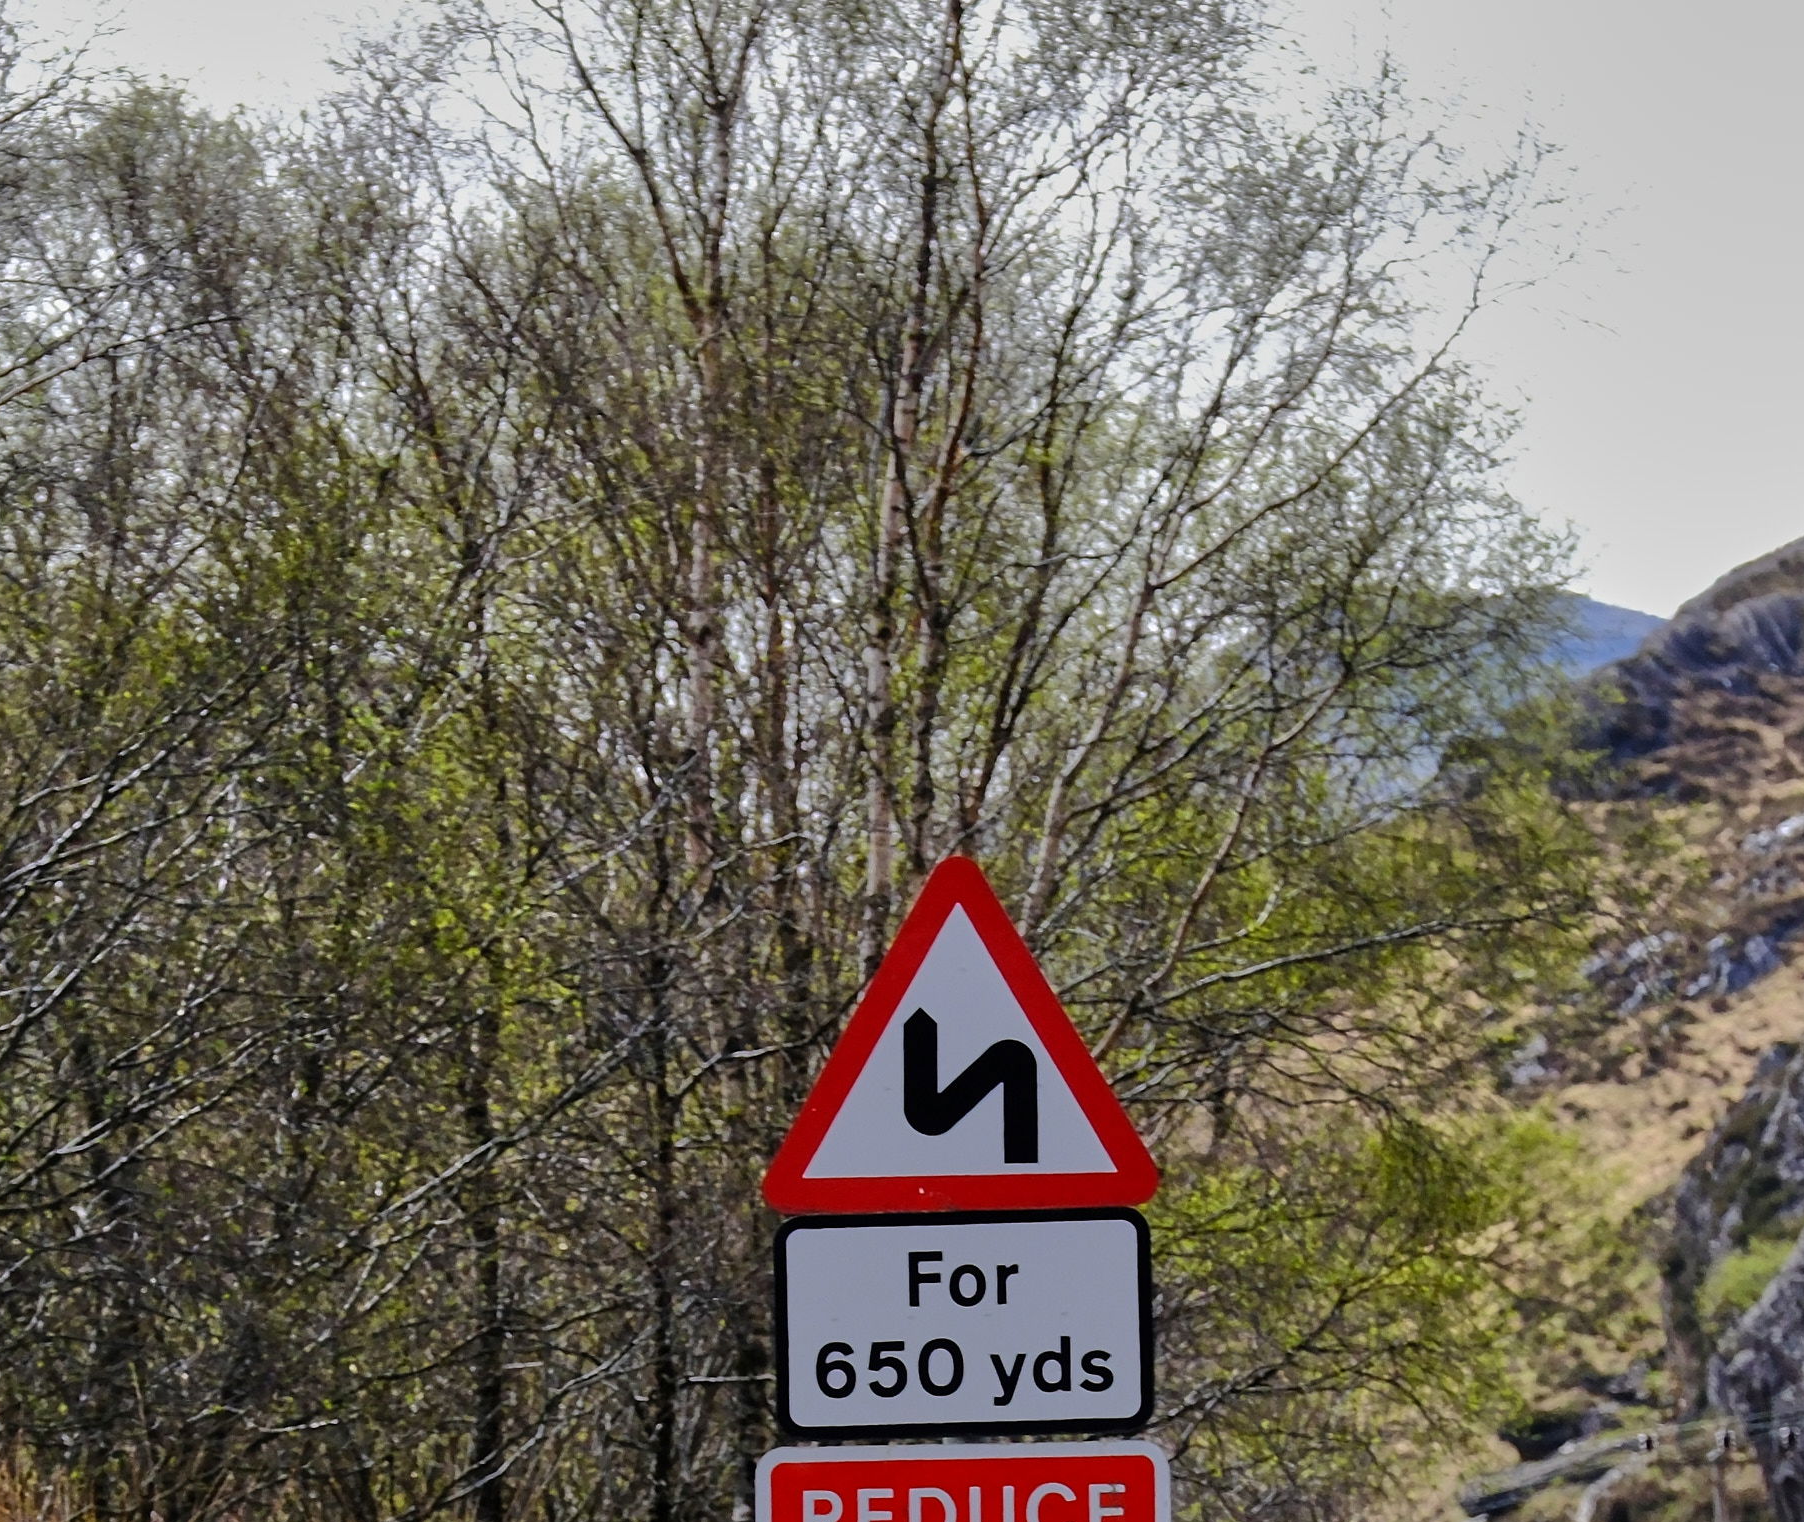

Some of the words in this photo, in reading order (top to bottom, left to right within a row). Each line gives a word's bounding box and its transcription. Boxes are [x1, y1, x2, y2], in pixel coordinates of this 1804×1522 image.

[907, 1250, 1020, 1308] For
[815, 1337, 965, 1399] 650
[989, 1335, 1115, 1407] yds
